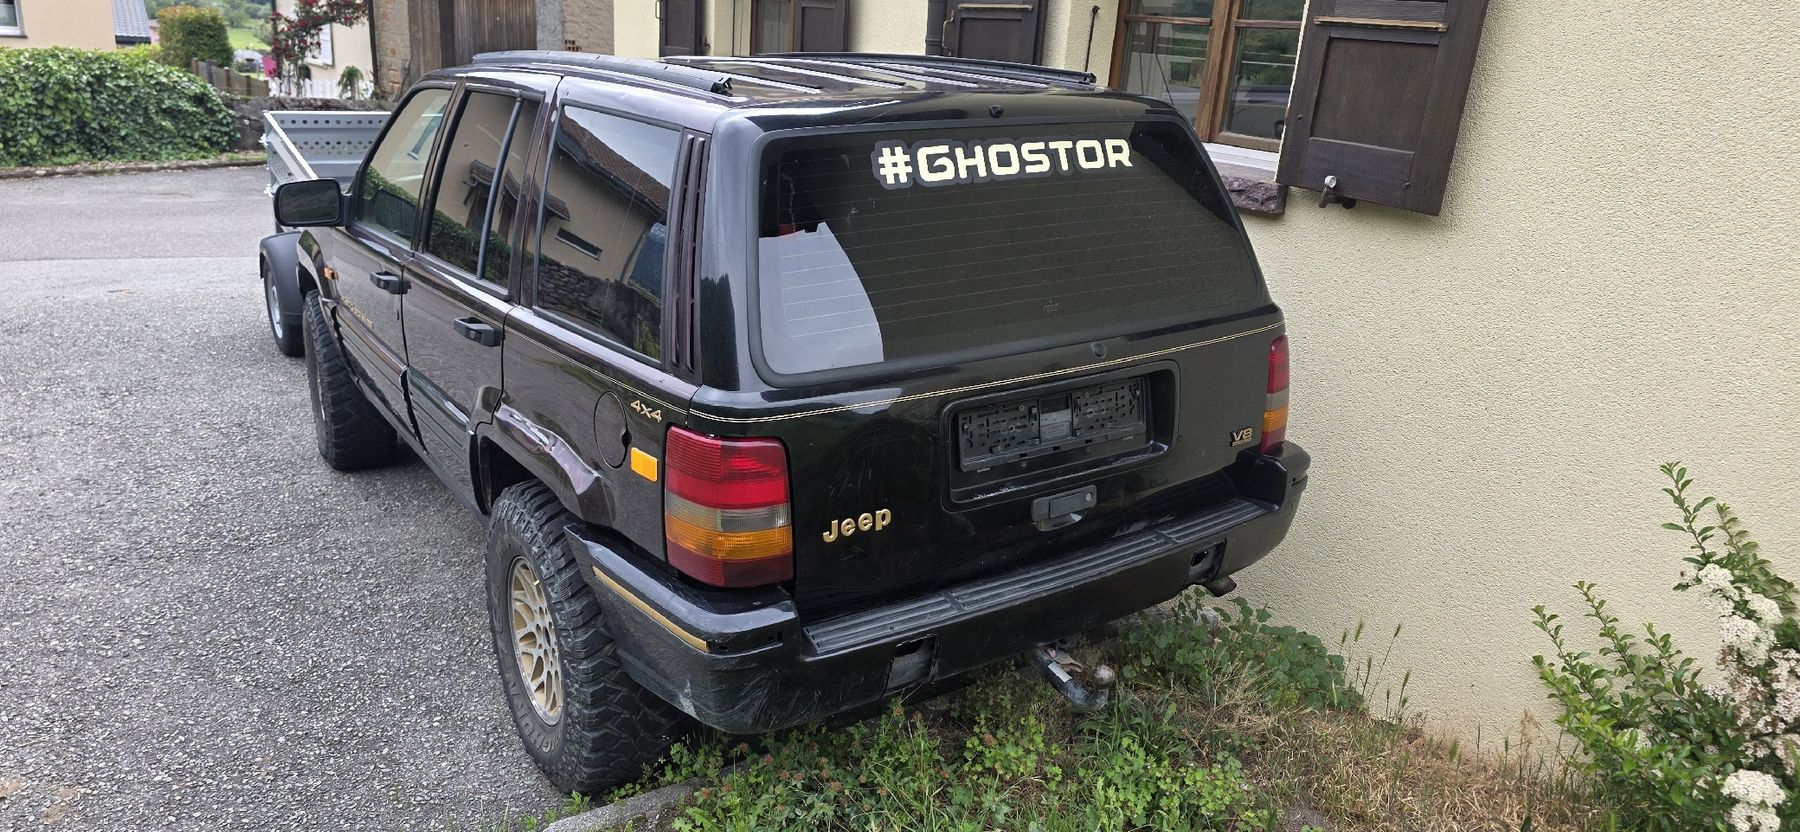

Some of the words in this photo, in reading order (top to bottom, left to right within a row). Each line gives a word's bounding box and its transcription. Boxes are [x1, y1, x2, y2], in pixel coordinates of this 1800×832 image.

[877, 138, 1134, 185] #GHOSTOR
[1232, 427, 1253, 441] V8
[822, 508, 892, 543] Jeep
